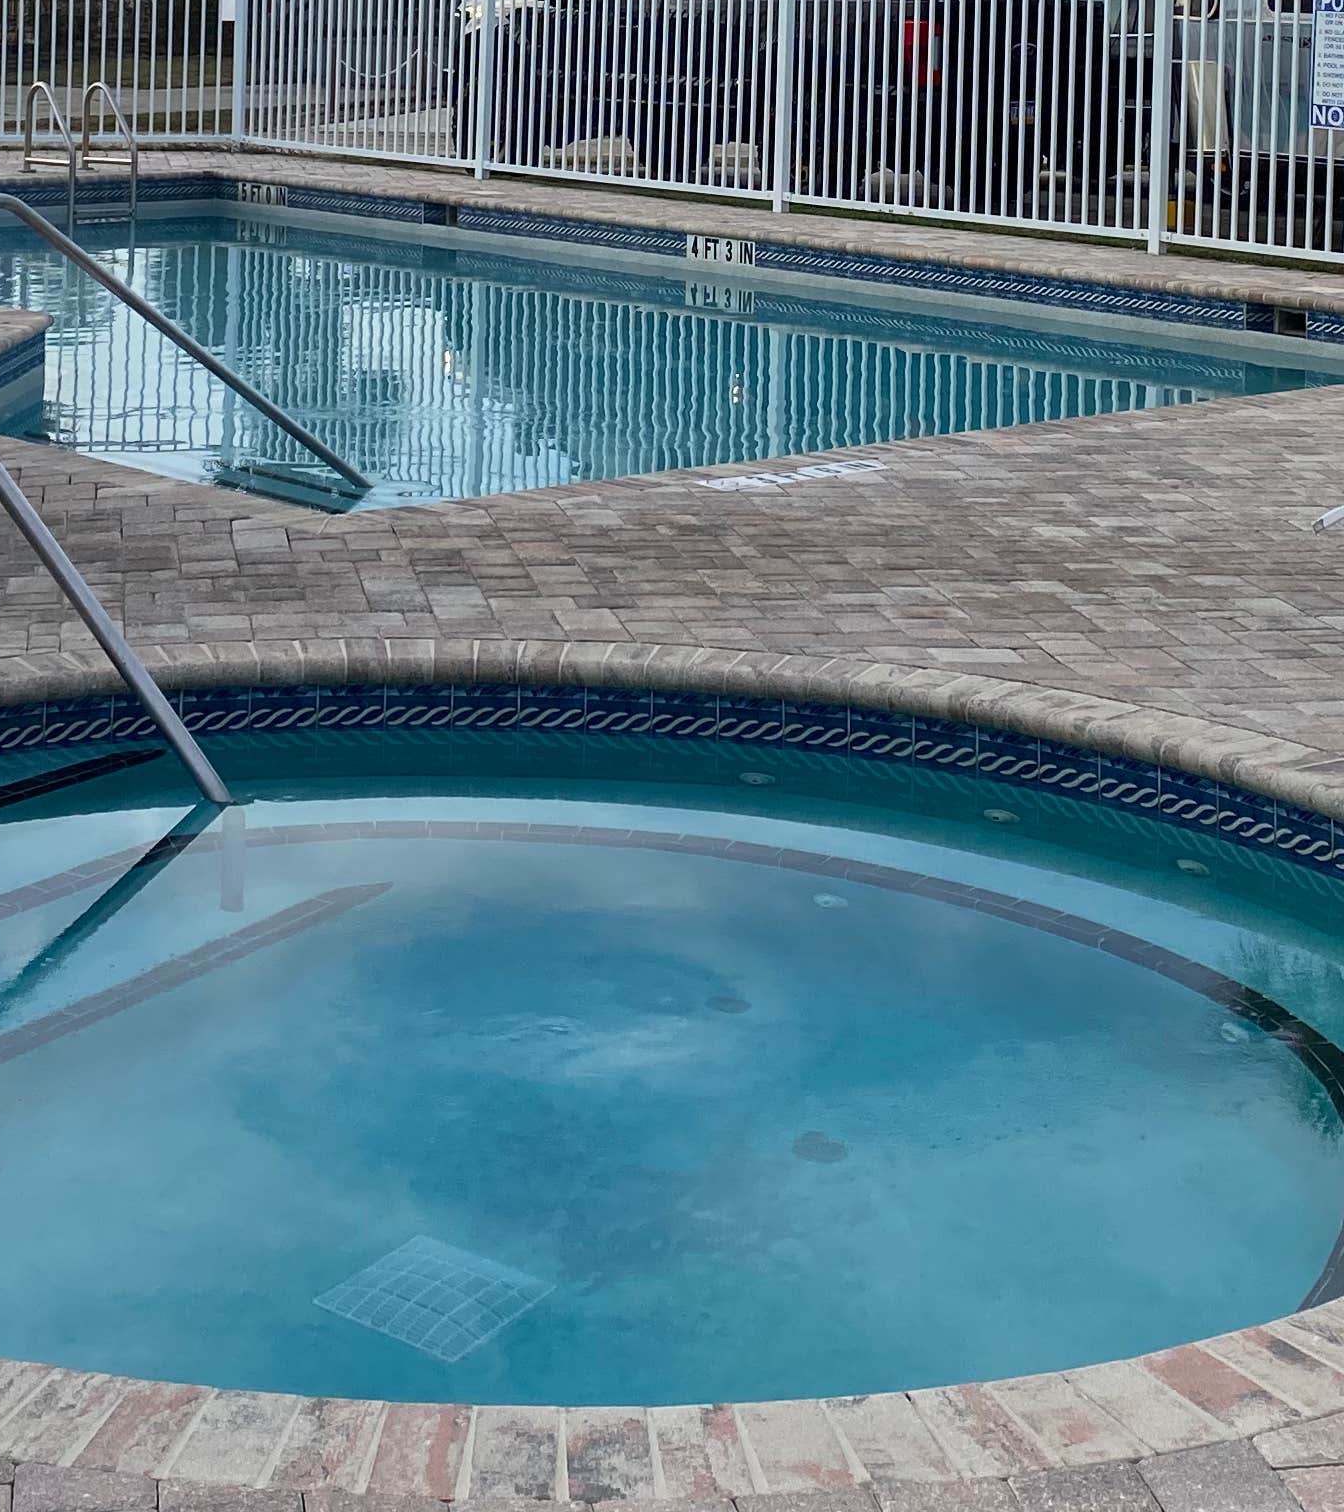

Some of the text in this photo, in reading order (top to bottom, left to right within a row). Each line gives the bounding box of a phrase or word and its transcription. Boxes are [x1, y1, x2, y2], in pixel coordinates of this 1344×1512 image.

[1312, 105, 1344, 126] NO
[241, 183, 247, 201] 5
[250, 185, 261, 203] FT
[275, 186, 286, 206] IN
[691, 235, 754, 265] 4 FT 3 IN
